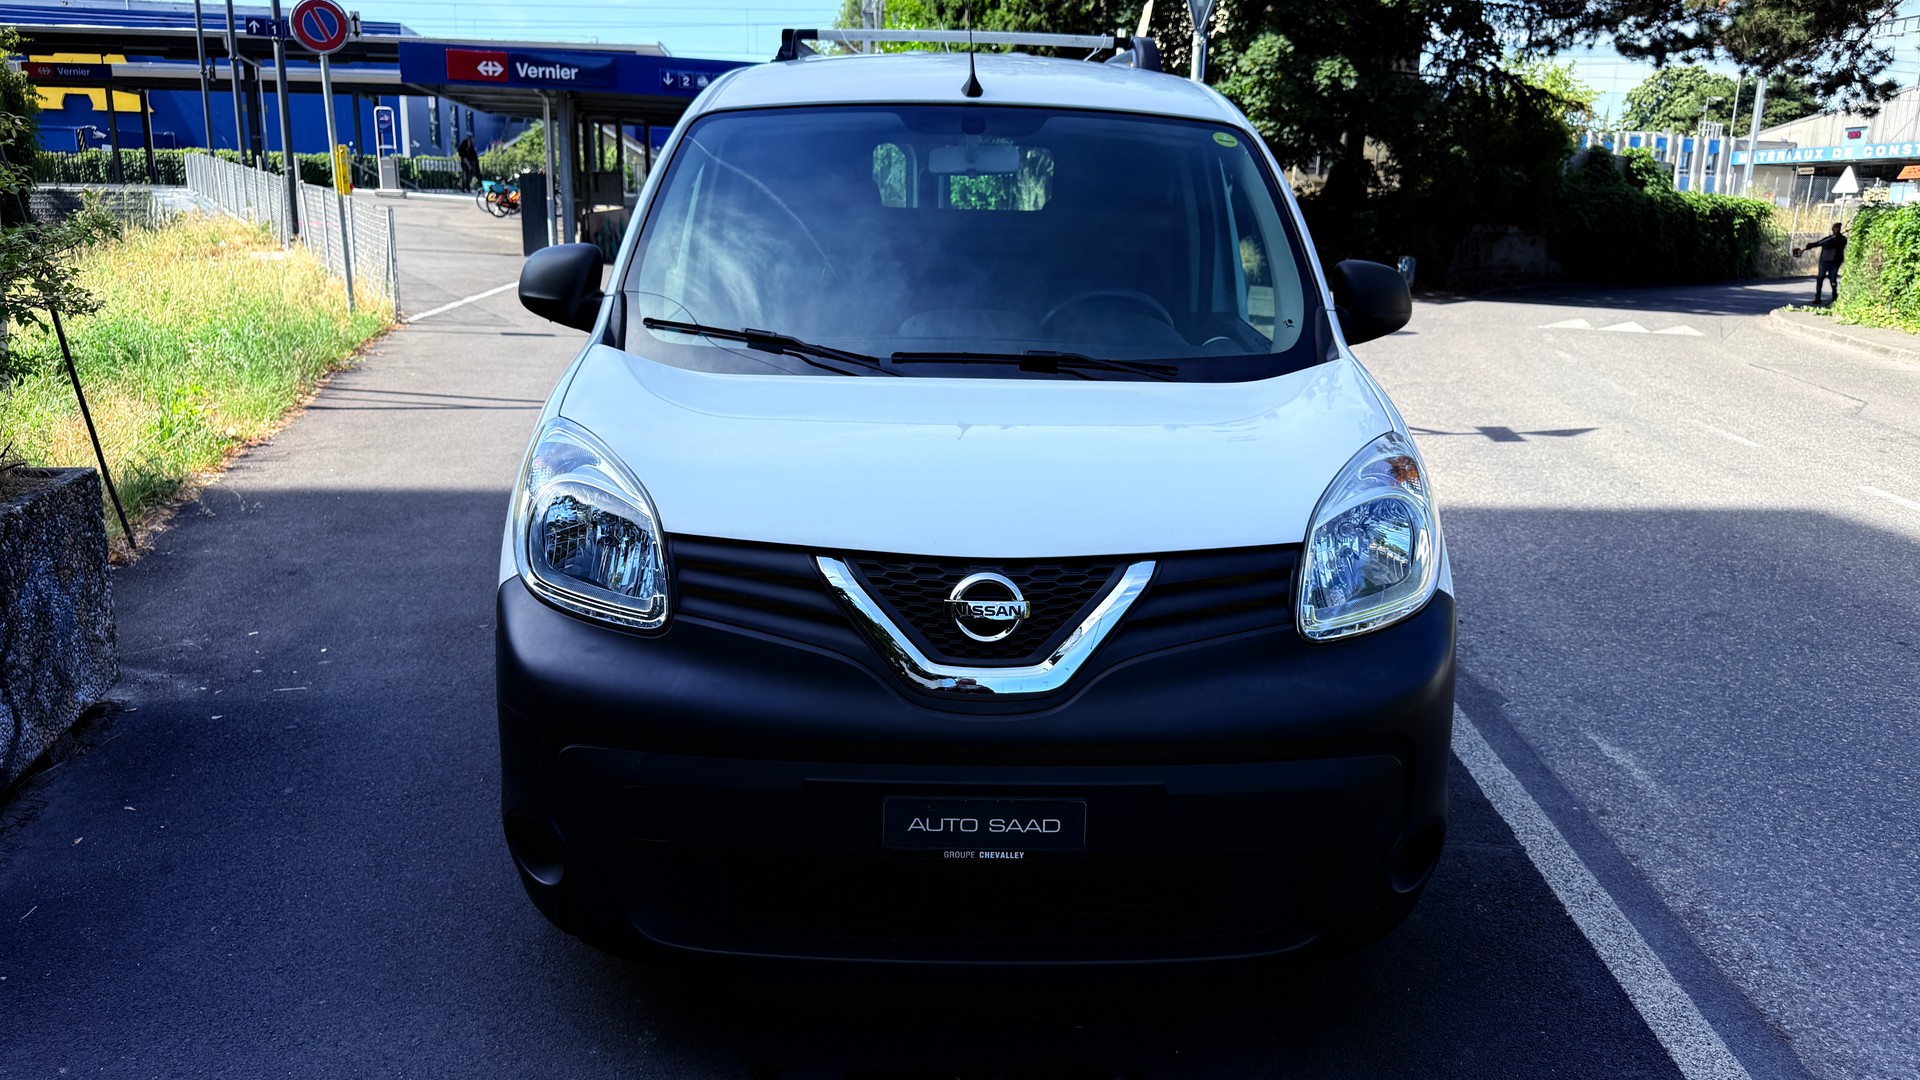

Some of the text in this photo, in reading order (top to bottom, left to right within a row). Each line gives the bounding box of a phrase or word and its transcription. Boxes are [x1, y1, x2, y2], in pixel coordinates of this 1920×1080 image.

[271, 25, 277, 35] 1
[57, 67, 90, 76] Vernier
[515, 62, 579, 80] Vernier
[682, 76, 690, 86] 2
[1832, 148, 1853, 159] DE
[951, 602, 1022, 617] NISSAN
[908, 817, 1060, 833] AUTO SAAD
[943, 851, 1025, 860] GROUPE CHEVALLEY
